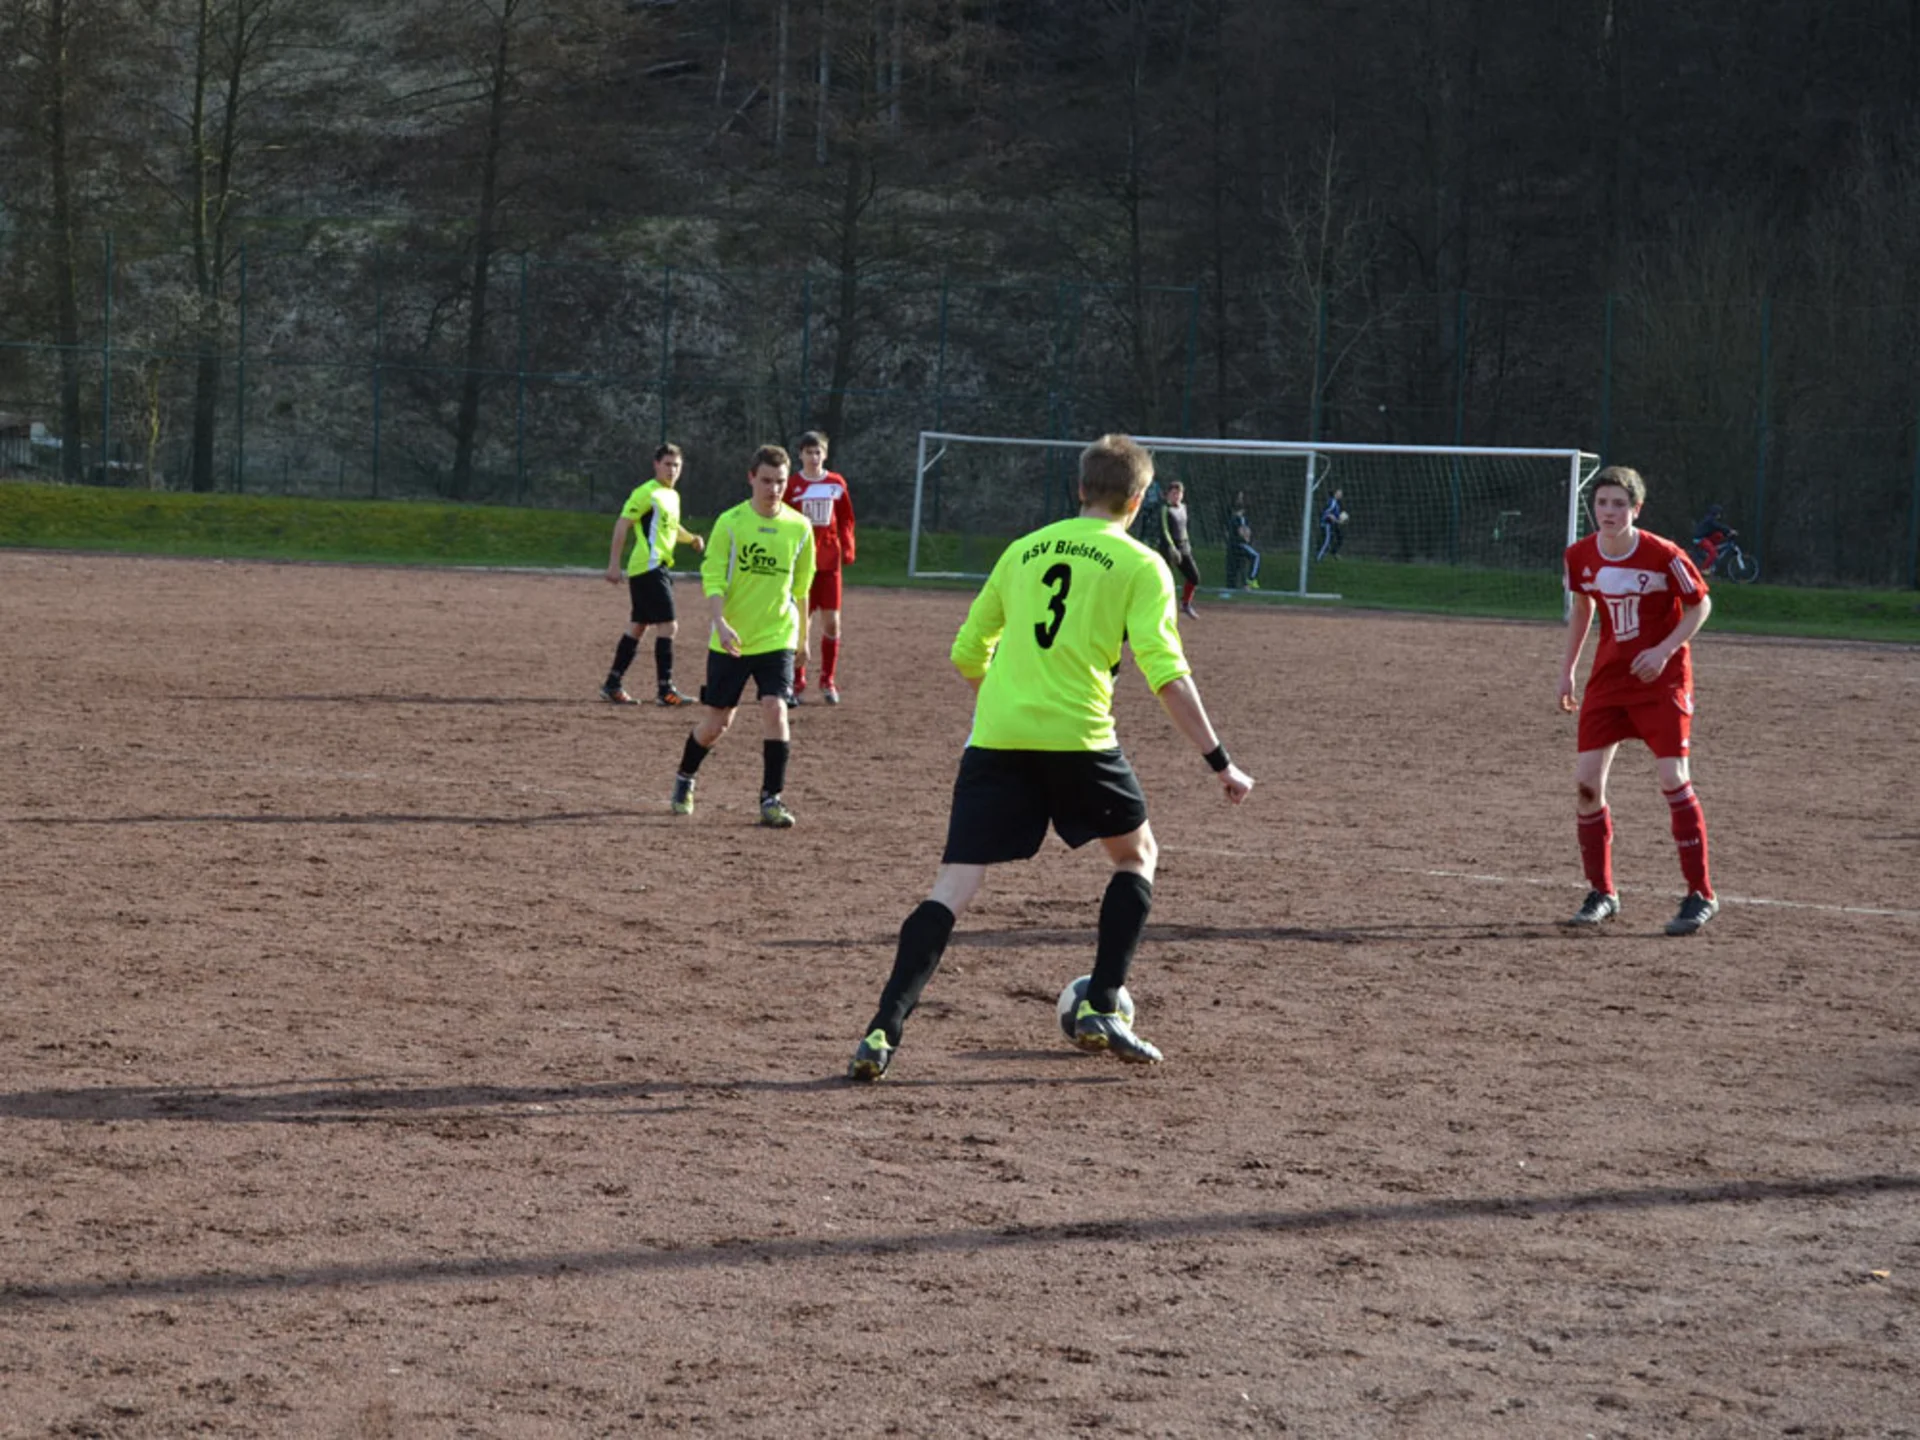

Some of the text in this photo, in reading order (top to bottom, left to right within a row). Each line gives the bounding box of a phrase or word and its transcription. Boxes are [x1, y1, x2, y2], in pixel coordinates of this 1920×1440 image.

[1055, 541, 1115, 571] Bielstein
[1638, 573, 1650, 592] 9
[1034, 562, 1072, 649] 3
